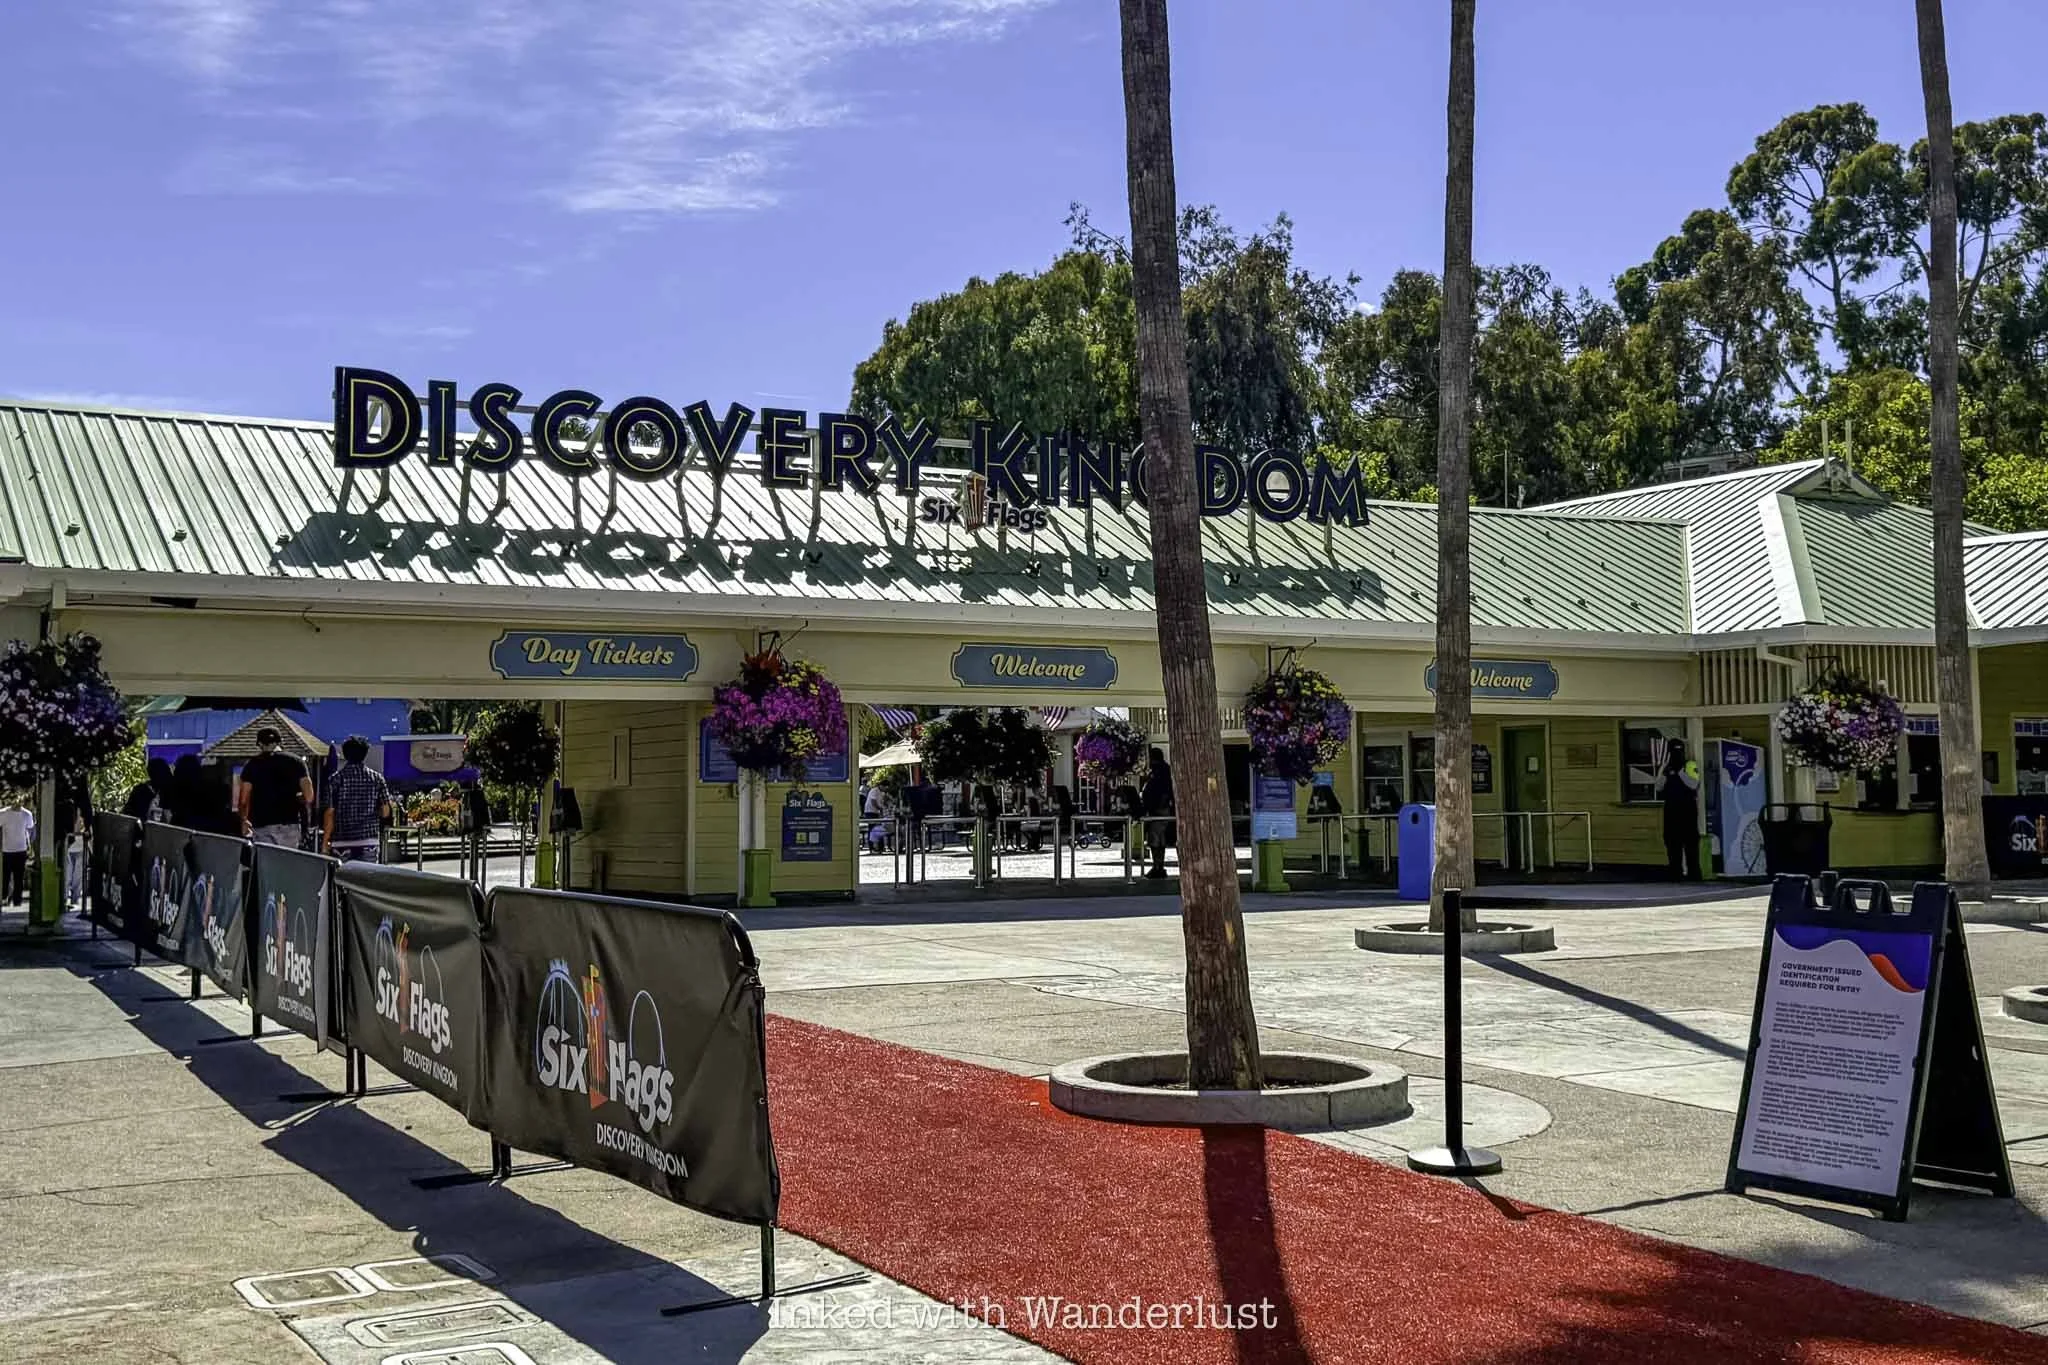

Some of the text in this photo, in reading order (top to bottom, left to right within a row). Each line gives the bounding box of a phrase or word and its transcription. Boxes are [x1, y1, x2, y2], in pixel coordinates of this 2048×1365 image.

[335, 366, 938, 497] DISCOVERY
[921, 497, 1048, 534] Six Flags
[522, 637, 675, 676] Day Tickets
[991, 653, 1086, 681] Welcome
[2011, 833, 2037, 852] Six
[265, 934, 279, 977] Six
[284, 941, 312, 997] Flags
[1780, 970, 1840, 983] IDENTIFICATION
[1782, 962, 1863, 977] GOVERNMENT ISSUED
[1779, 978, 1861, 993] REQUIRED FOR ENTRY
[375, 966, 451, 1054] Six Flags
[540, 1025, 674, 1132] Six Flags
[596, 1122, 644, 1160] DISCOVERY
